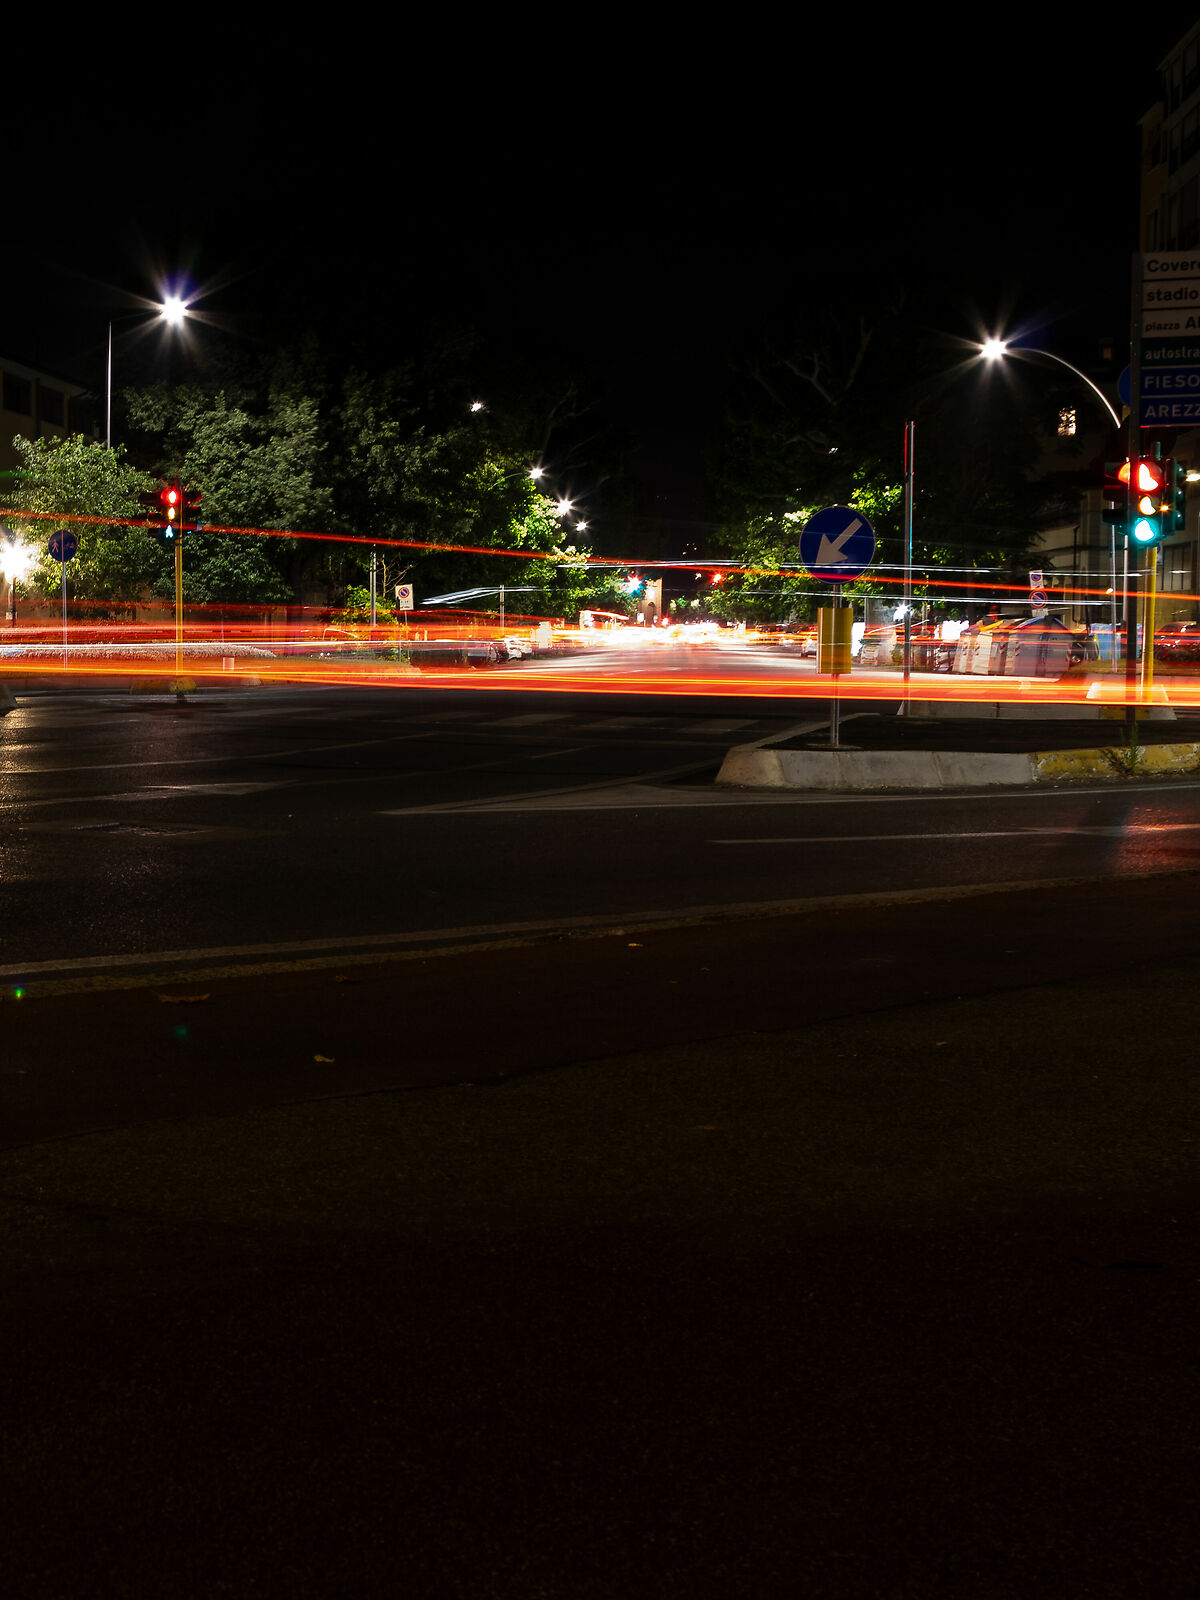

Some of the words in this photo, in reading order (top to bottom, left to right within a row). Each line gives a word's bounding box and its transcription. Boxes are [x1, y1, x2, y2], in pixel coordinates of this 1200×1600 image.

[1147, 259, 1200, 273] Cover
[1146, 287, 1199, 302] stadio
[1145, 321, 1180, 332] piazza
[1185, 316, 1200, 329] A
[1145, 346, 1200, 360] autostra
[1144, 374, 1200, 389] FIESO
